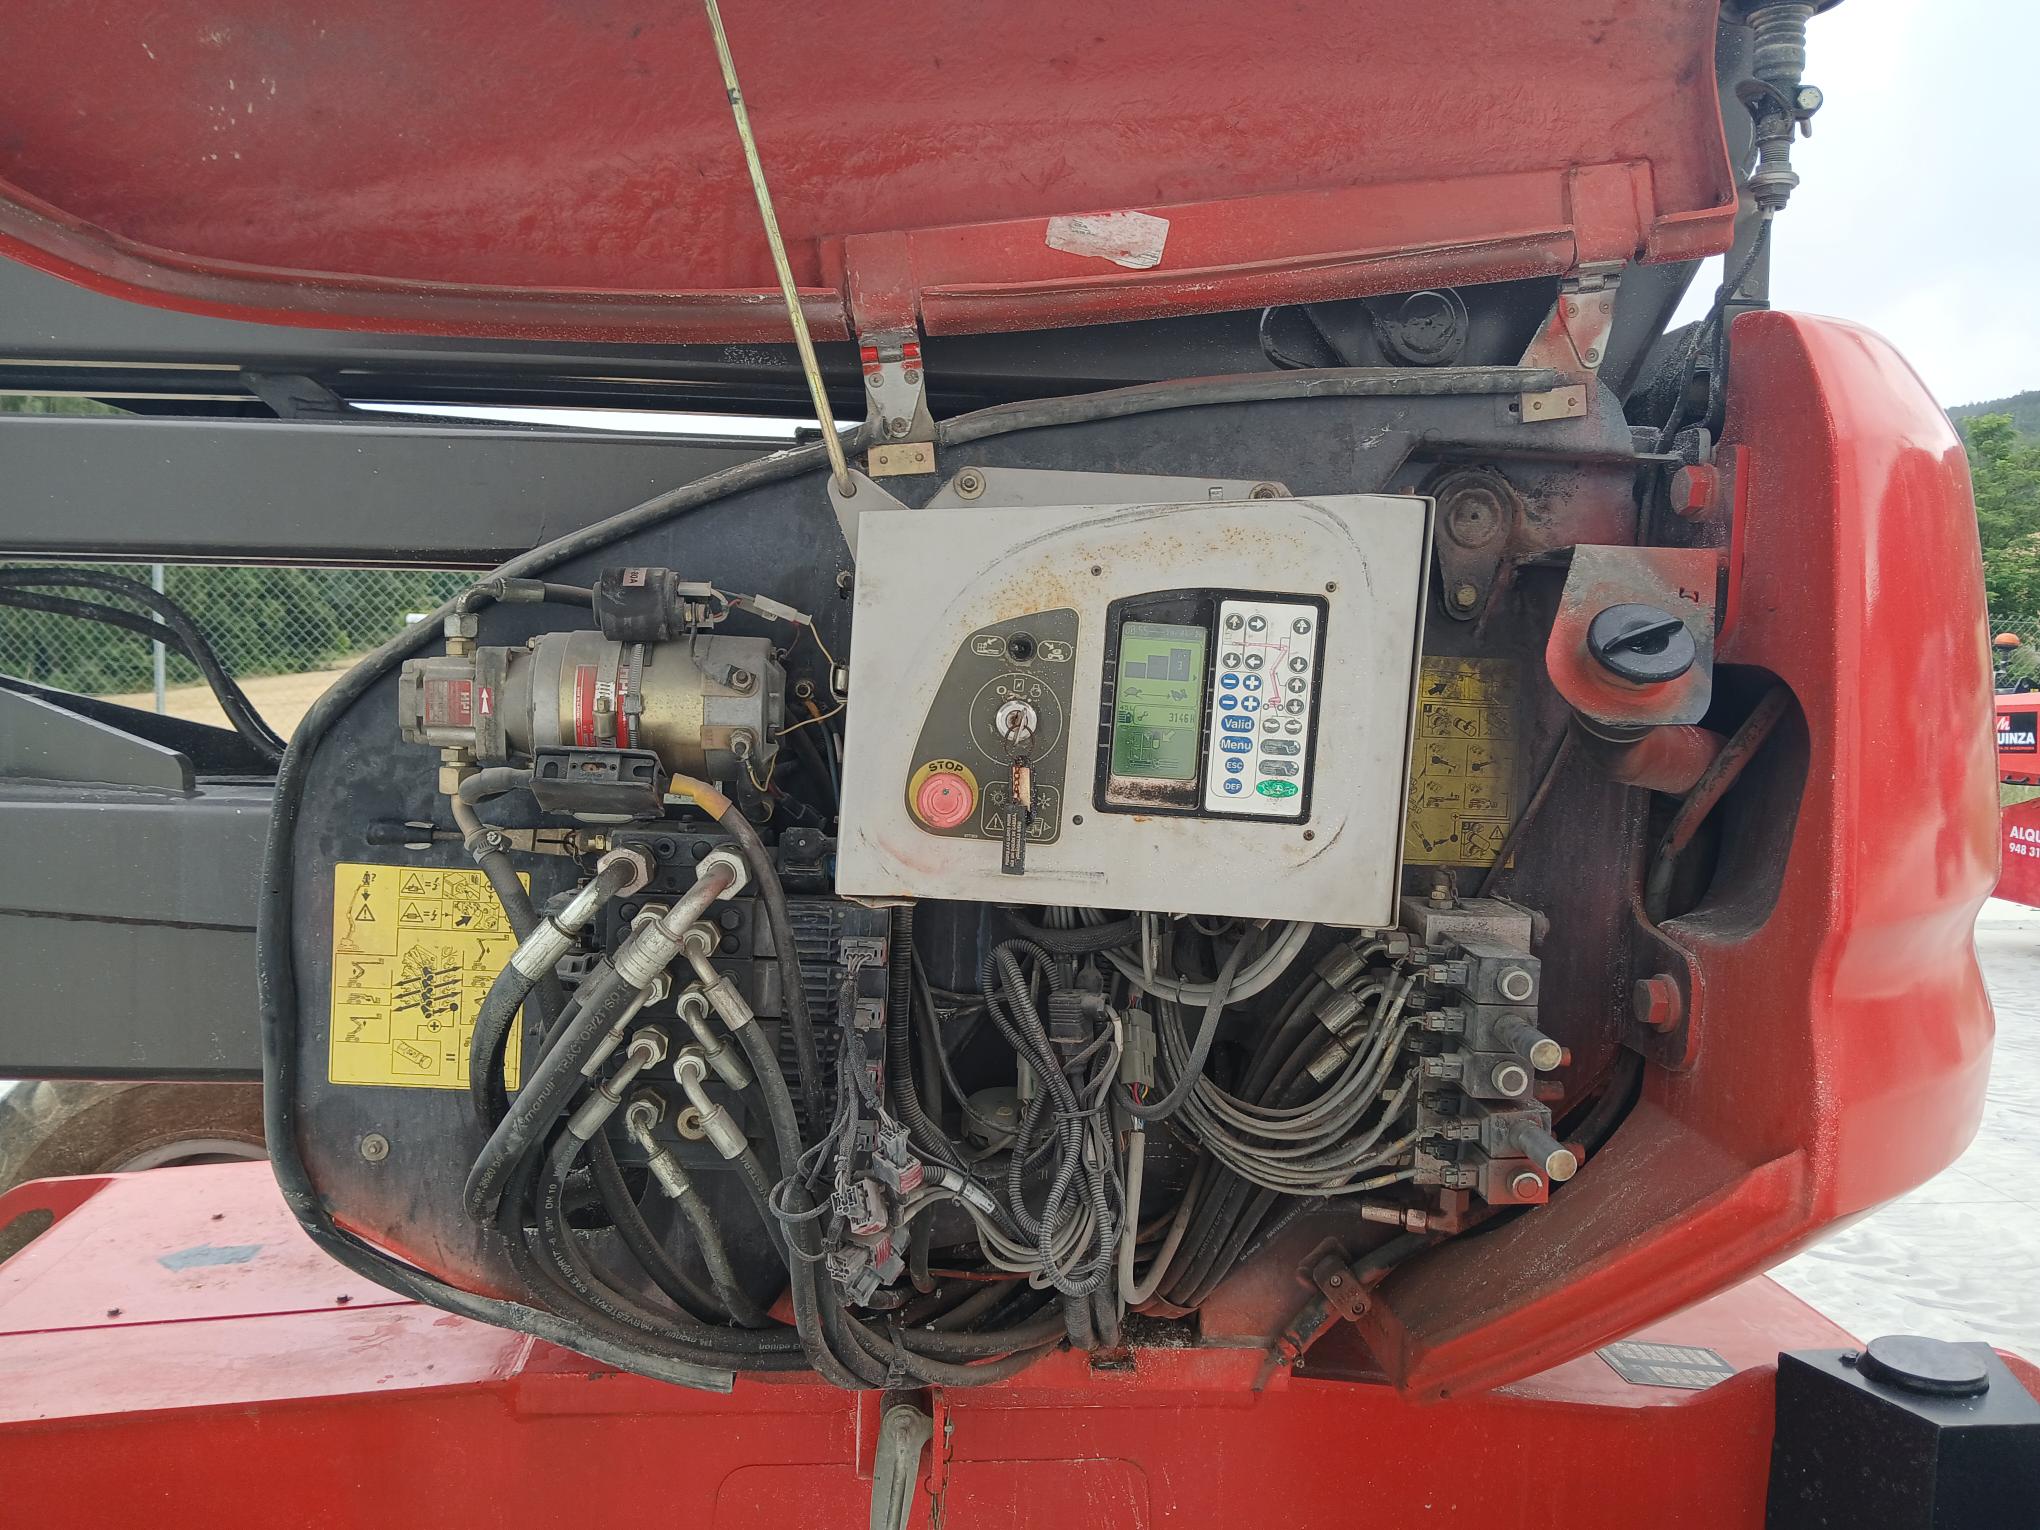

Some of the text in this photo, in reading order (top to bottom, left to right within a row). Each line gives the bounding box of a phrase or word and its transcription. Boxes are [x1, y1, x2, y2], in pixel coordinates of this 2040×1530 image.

[1224, 718, 1252, 730] Valid
[1221, 740, 1252, 750] Menu
[928, 760, 964, 773] STOP
[2009, 842, 2026, 855] 948
[544, 1196, 555, 1210] DN
